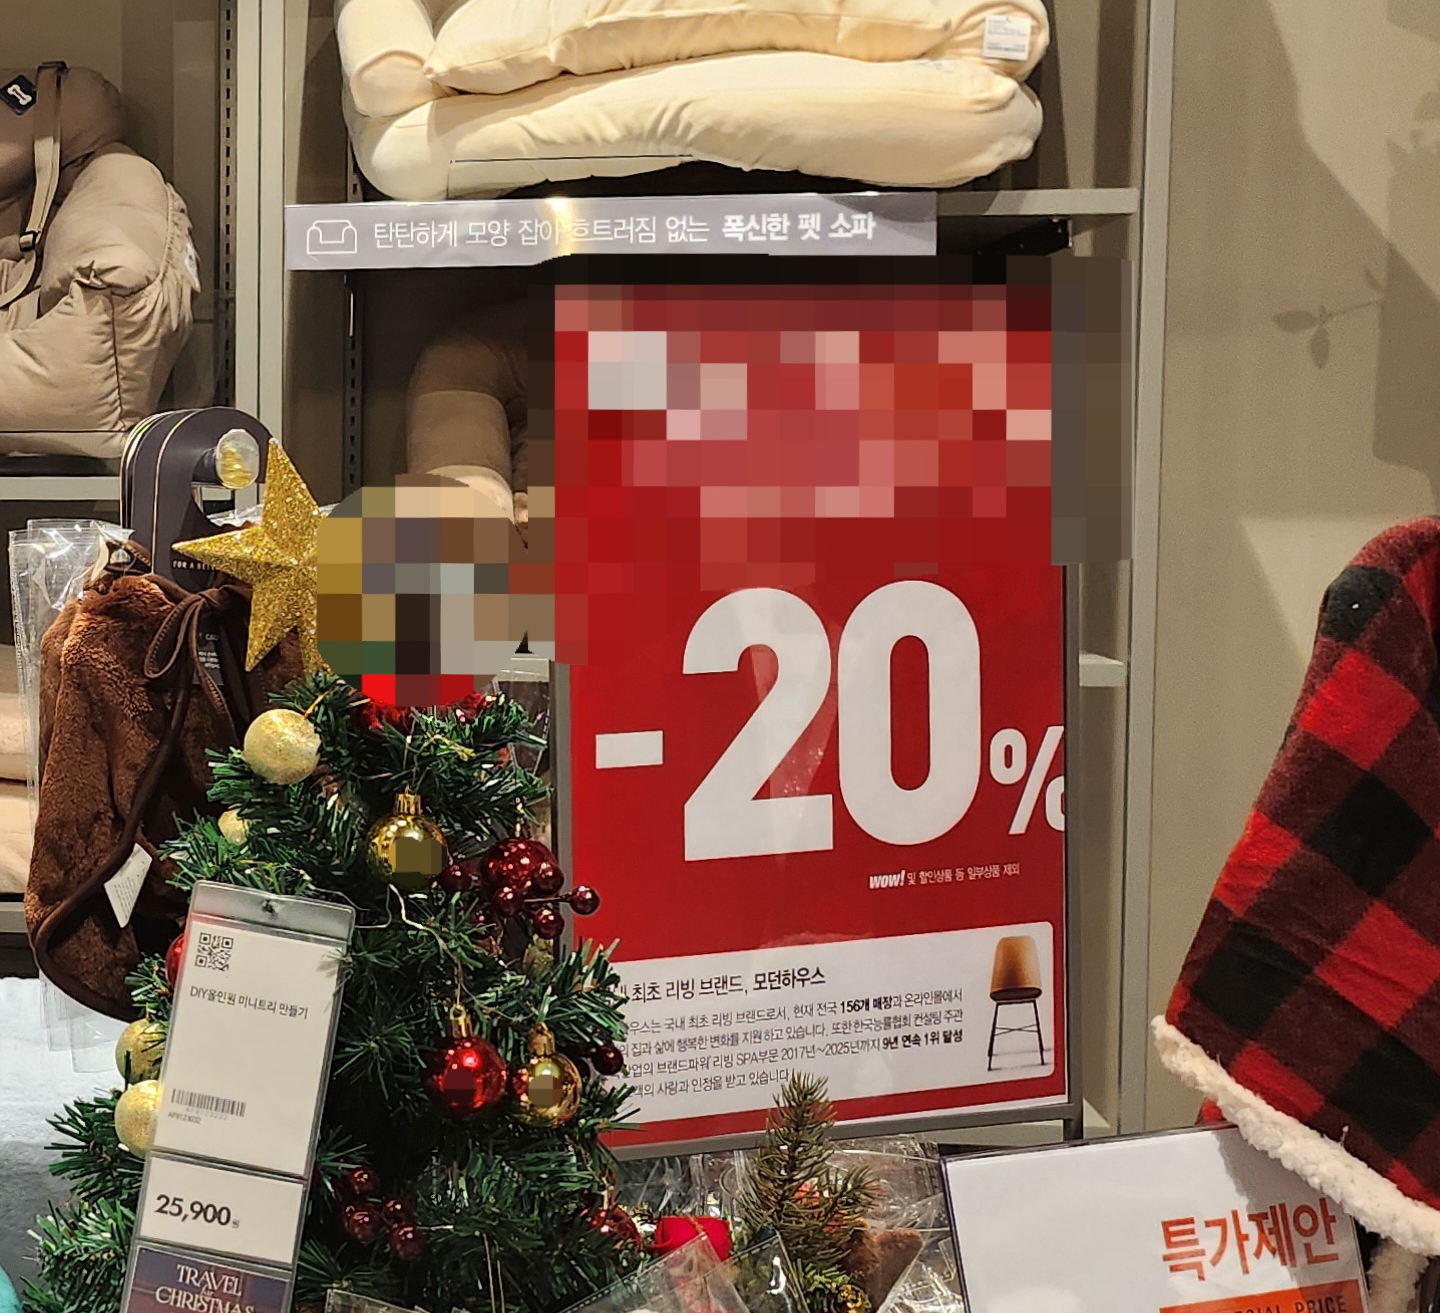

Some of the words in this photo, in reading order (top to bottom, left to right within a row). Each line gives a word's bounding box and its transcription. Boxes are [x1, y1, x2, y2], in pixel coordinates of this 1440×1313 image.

[374, 220, 458, 249] 탄탄하게
[465, 220, 510, 247] 모양
[570, 216, 657, 244] 흐트러짐
[665, 216, 710, 243] 없는
[722, 212, 791, 242] 폭신한
[797, 212, 821, 241] 펫
[828, 210, 877, 240] 소파
[595, 580, 1064, 861] -20%
[906, 872, 916, 886] 및
[918, 869, 953, 885] 할인상품
[955, 867, 964, 882] 등
[967, 864, 1001, 880] 일부상품
[1003, 862, 1020, 876] 제외
[632, 981, 662, 1003] 최초
[665, 978, 695, 1001] 리빙
[698, 975, 748, 996] 브랜드,
[753, 966, 826, 992] 모던하우스
[238, 995, 277, 1014] 미니트리
[279, 1002, 309, 1020] 만들기
[664, 1017, 686, 1032] 국내
[688, 1015, 710, 1030] 최초
[712, 1012, 733, 1027] 리빙
[735, 1006, 790, 1024] 브랜드로서,
[793, 1003, 813, 1019] 현재
[817, 1001, 837, 1016] 전국
[840, 997, 869, 1014] 156개
[872, 995, 902, 1010] 매장과
[904, 988, 963, 1007] 온라인몰에서
[631, 1041, 652, 1057] 집과
[654, 1039, 675, 1055] 삶에
[677, 1036, 708, 1053] 행복한
[710, 1032, 740, 1049] 변화를
[831, 1020, 852, 1036] 또한
[854, 1014, 911, 1033] 한국능률협회
[914, 1010, 942, 1028] 컨설팅
[944, 1008, 963, 1023] 주관
[713, 1054, 733, 1069] 리빙
[736, 1048, 779, 1066] SPA부문
[882, 1034, 899, 1050] 9년
[902, 1032, 921, 1048] 연속
[924, 1030, 940, 1045] 1위
[943, 1028, 963, 1043] 달성
[657, 1079, 689, 1096] 사랑과
[691, 1076, 723, 1093] 인정을
[725, 1073, 747, 1088] 받고
[1161, 1198, 1339, 1281] 특가제안
[176, 1264, 242, 1297] TRAVEL
